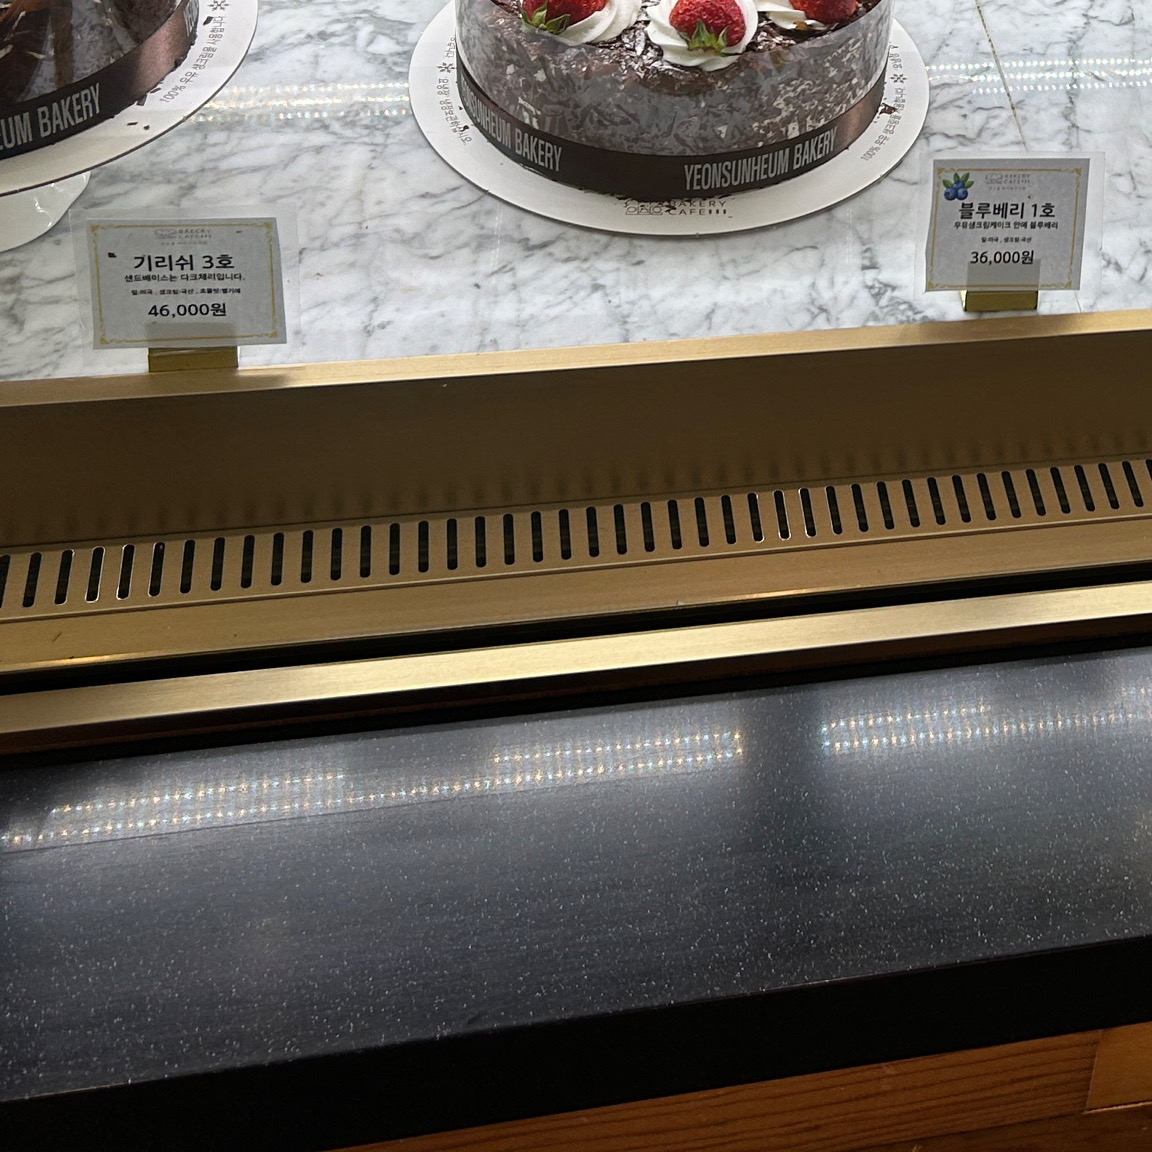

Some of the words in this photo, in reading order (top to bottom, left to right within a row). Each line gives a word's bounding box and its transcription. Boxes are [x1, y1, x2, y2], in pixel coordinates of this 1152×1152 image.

[159, 85, 186, 103] 100%
[180, 71, 199, 85] 우유
[37, 82, 100, 138] BAKERY
[515, 128, 562, 172] BAKERY
[684, 148, 790, 191] YEONSUNHEUM
[793, 127, 838, 170] BAKERY
[958, 202, 1025, 219] 블루베리
[1031, 202, 1056, 219] 1호
[1030, 221, 1059, 230] 블루베리
[133, 254, 194, 272] 기리쉬
[202, 254, 235, 270] 3호
[970, 250, 1034, 266] 36,000원
[148, 302, 227, 319] 46,000원
